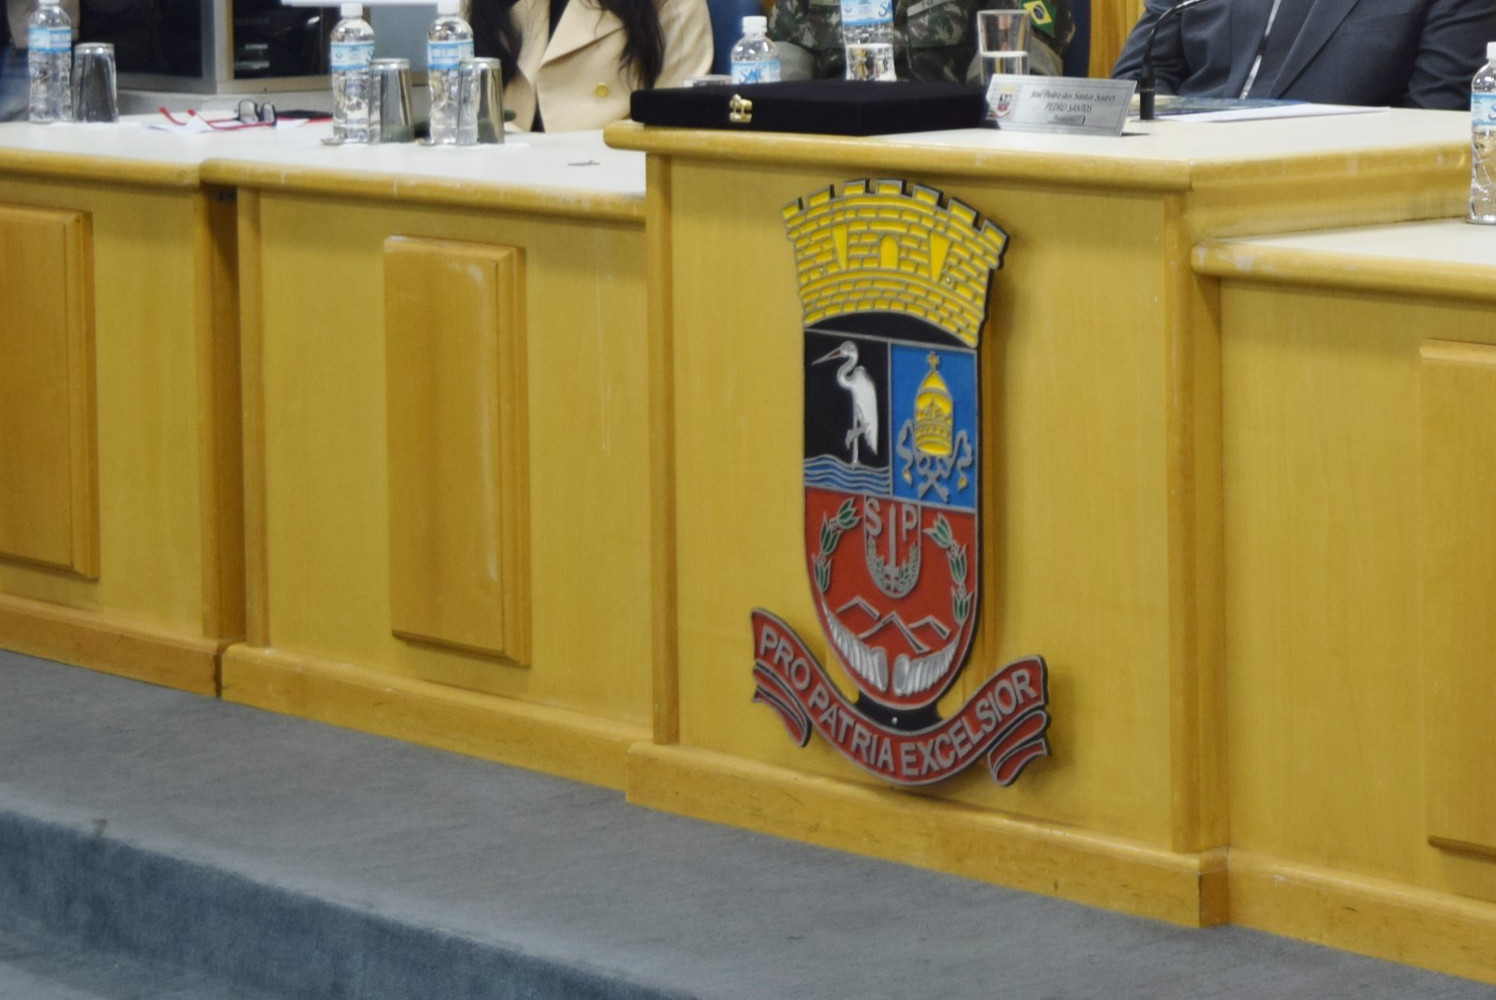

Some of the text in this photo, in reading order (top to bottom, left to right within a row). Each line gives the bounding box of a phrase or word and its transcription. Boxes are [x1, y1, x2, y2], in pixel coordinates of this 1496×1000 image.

[760, 624, 1038, 776] PRO PATRIA EXCELSIOR
